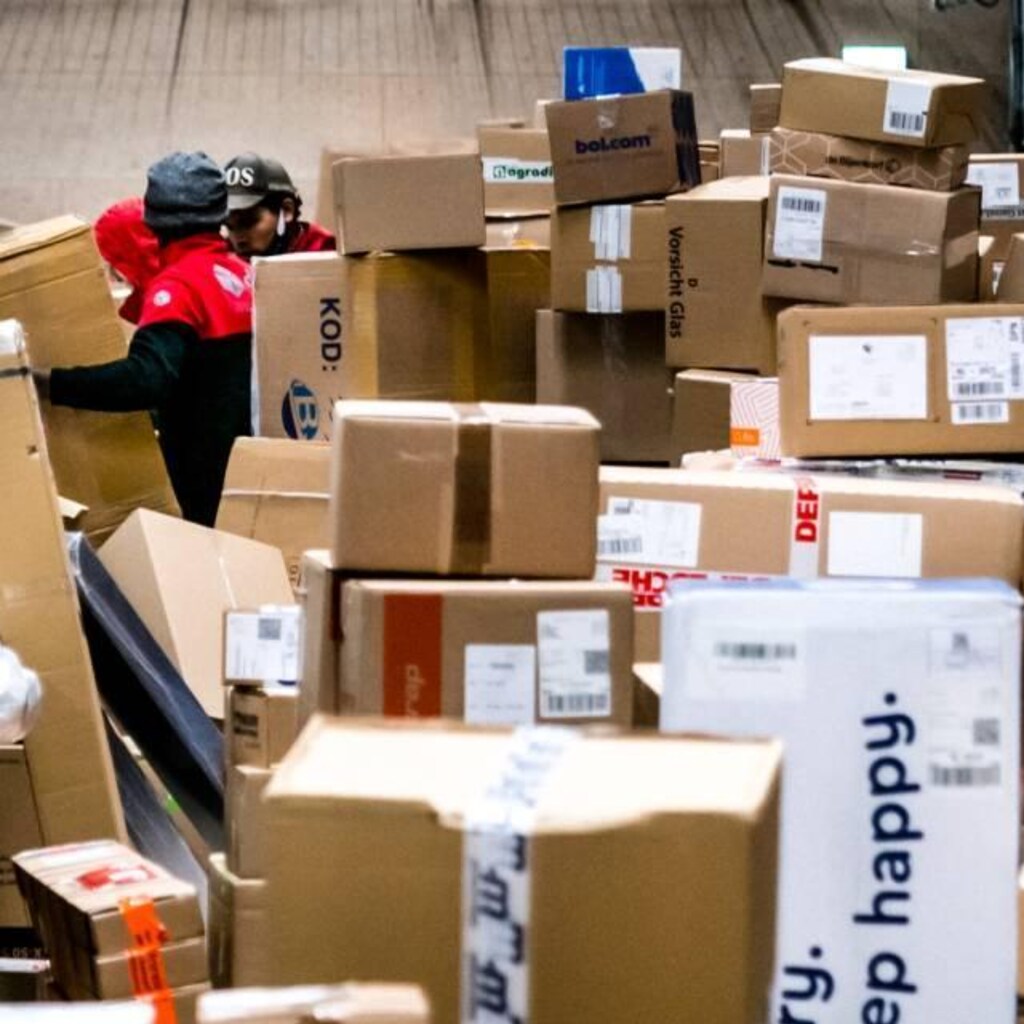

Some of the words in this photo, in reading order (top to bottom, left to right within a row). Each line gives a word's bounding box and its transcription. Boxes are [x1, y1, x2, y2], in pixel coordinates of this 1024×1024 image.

[575, 134, 651, 154] bol.com
[667, 225, 685, 296] Vorsicht
[319, 297, 343, 373] KOD:
[669, 301, 686, 339] Glas
[853, 692, 925, 926] happy.
